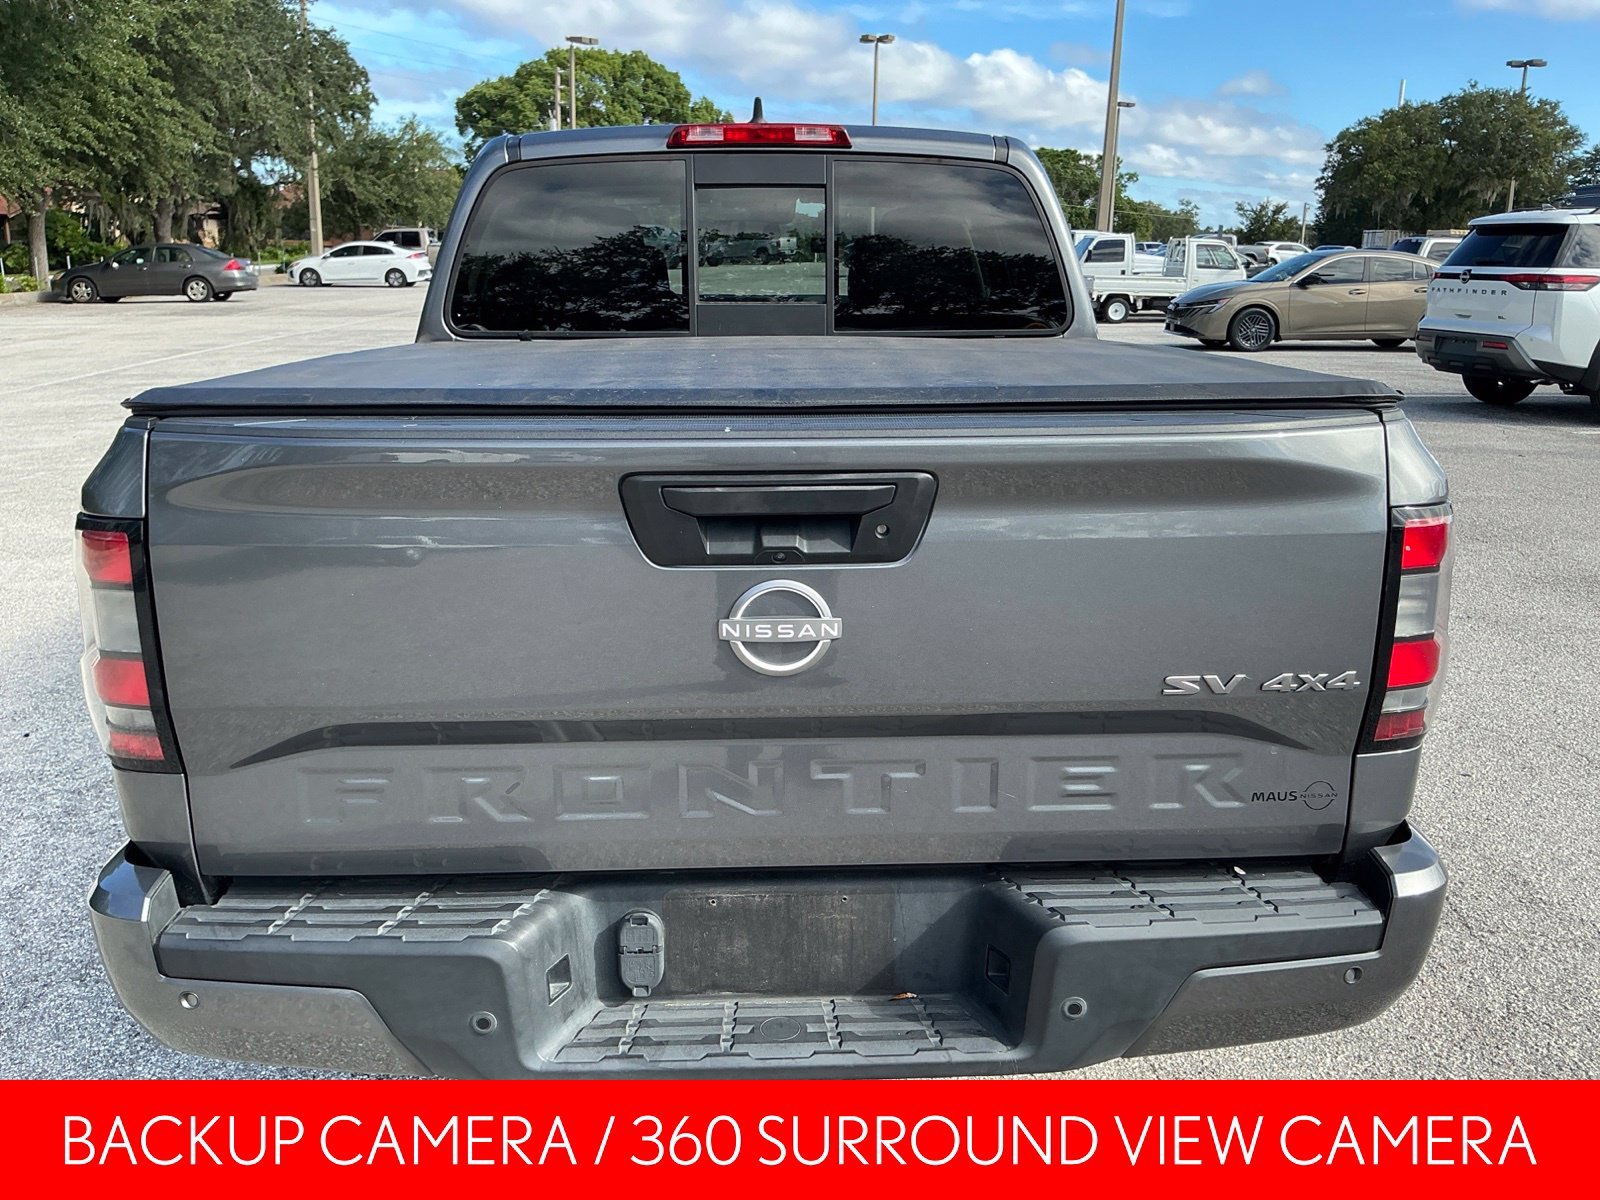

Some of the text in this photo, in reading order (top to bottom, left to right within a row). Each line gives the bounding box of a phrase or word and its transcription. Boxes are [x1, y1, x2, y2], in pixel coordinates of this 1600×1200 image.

[1431, 287, 1508, 296] PATHFINDER
[721, 621, 839, 639] NISSAN
[1161, 674, 1248, 695] SV
[298, 752, 1247, 824] FRONTIER
[1251, 790, 1339, 803] MAUS NISSAN
